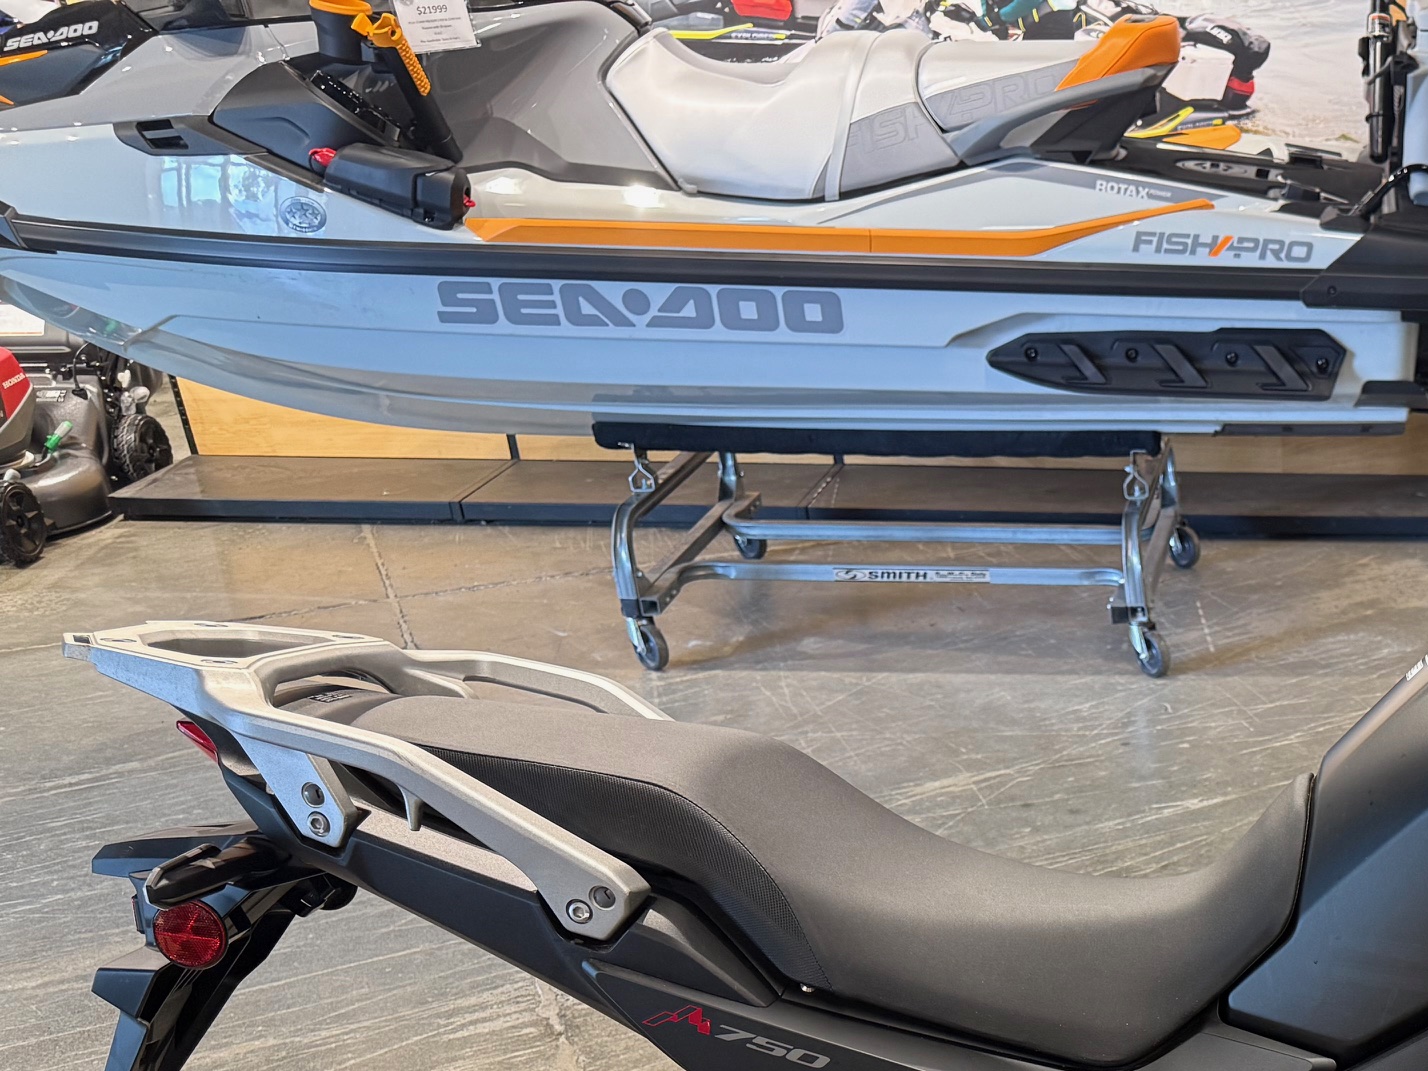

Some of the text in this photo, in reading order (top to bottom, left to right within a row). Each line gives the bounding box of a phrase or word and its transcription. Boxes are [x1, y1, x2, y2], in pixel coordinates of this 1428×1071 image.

[416, 5, 448, 15] $21999
[1096, 180, 1148, 200] ROTAX
[2, 372, 27, 390] HONDA
[868, 571, 928, 581] SMITH
[715, 1024, 831, 1069] 750
